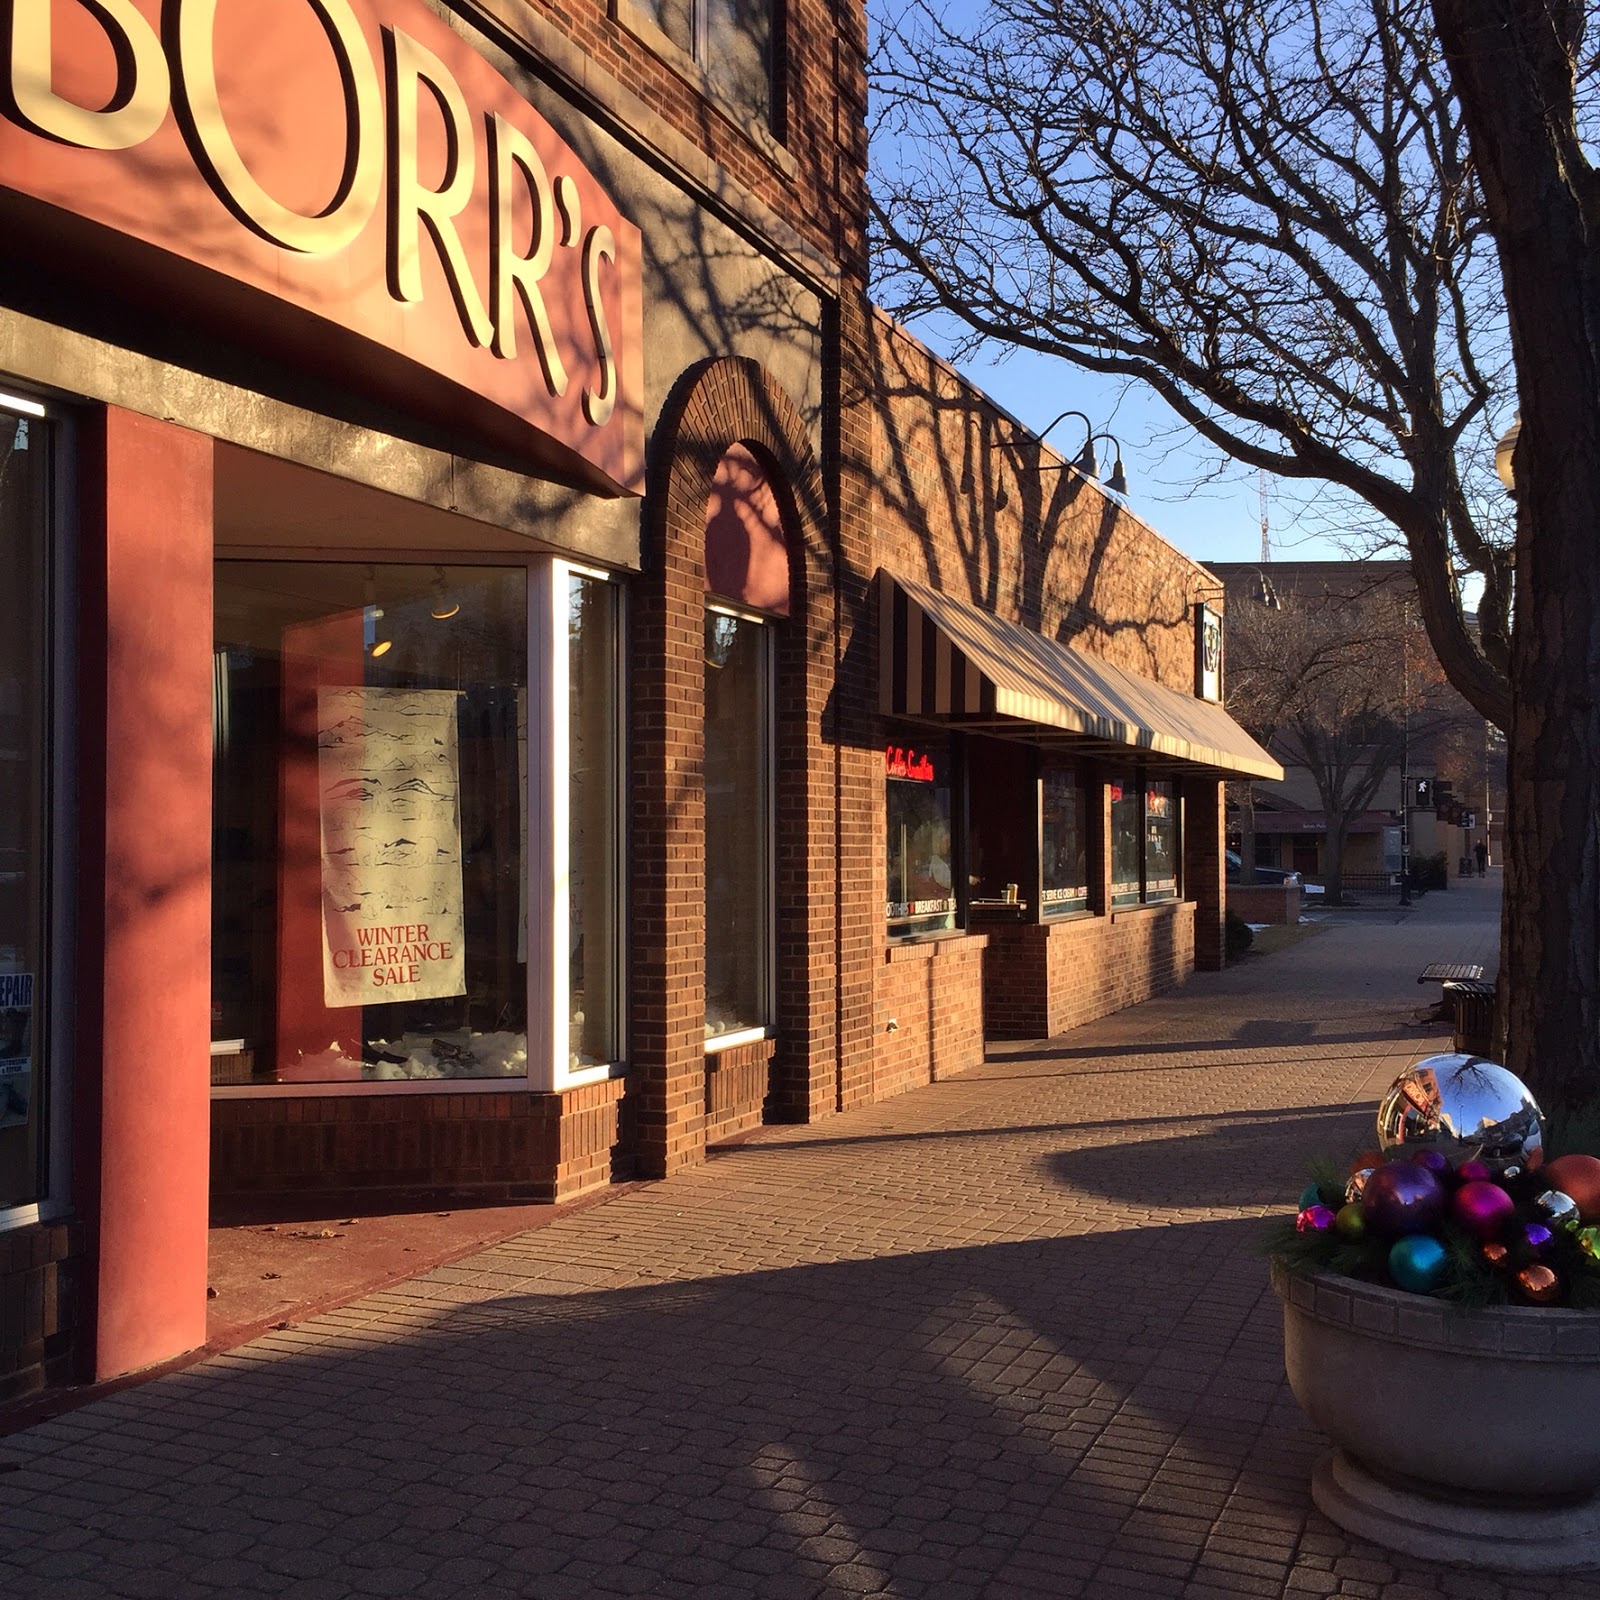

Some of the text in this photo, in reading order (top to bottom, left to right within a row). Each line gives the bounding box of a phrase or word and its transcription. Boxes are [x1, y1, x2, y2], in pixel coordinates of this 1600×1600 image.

[915, 899, 943, 914] BREAKFAST
[357, 924, 430, 946] WINTER
[332, 942, 453, 969] CLEARANCE
[372, 964, 421, 987] SALE
